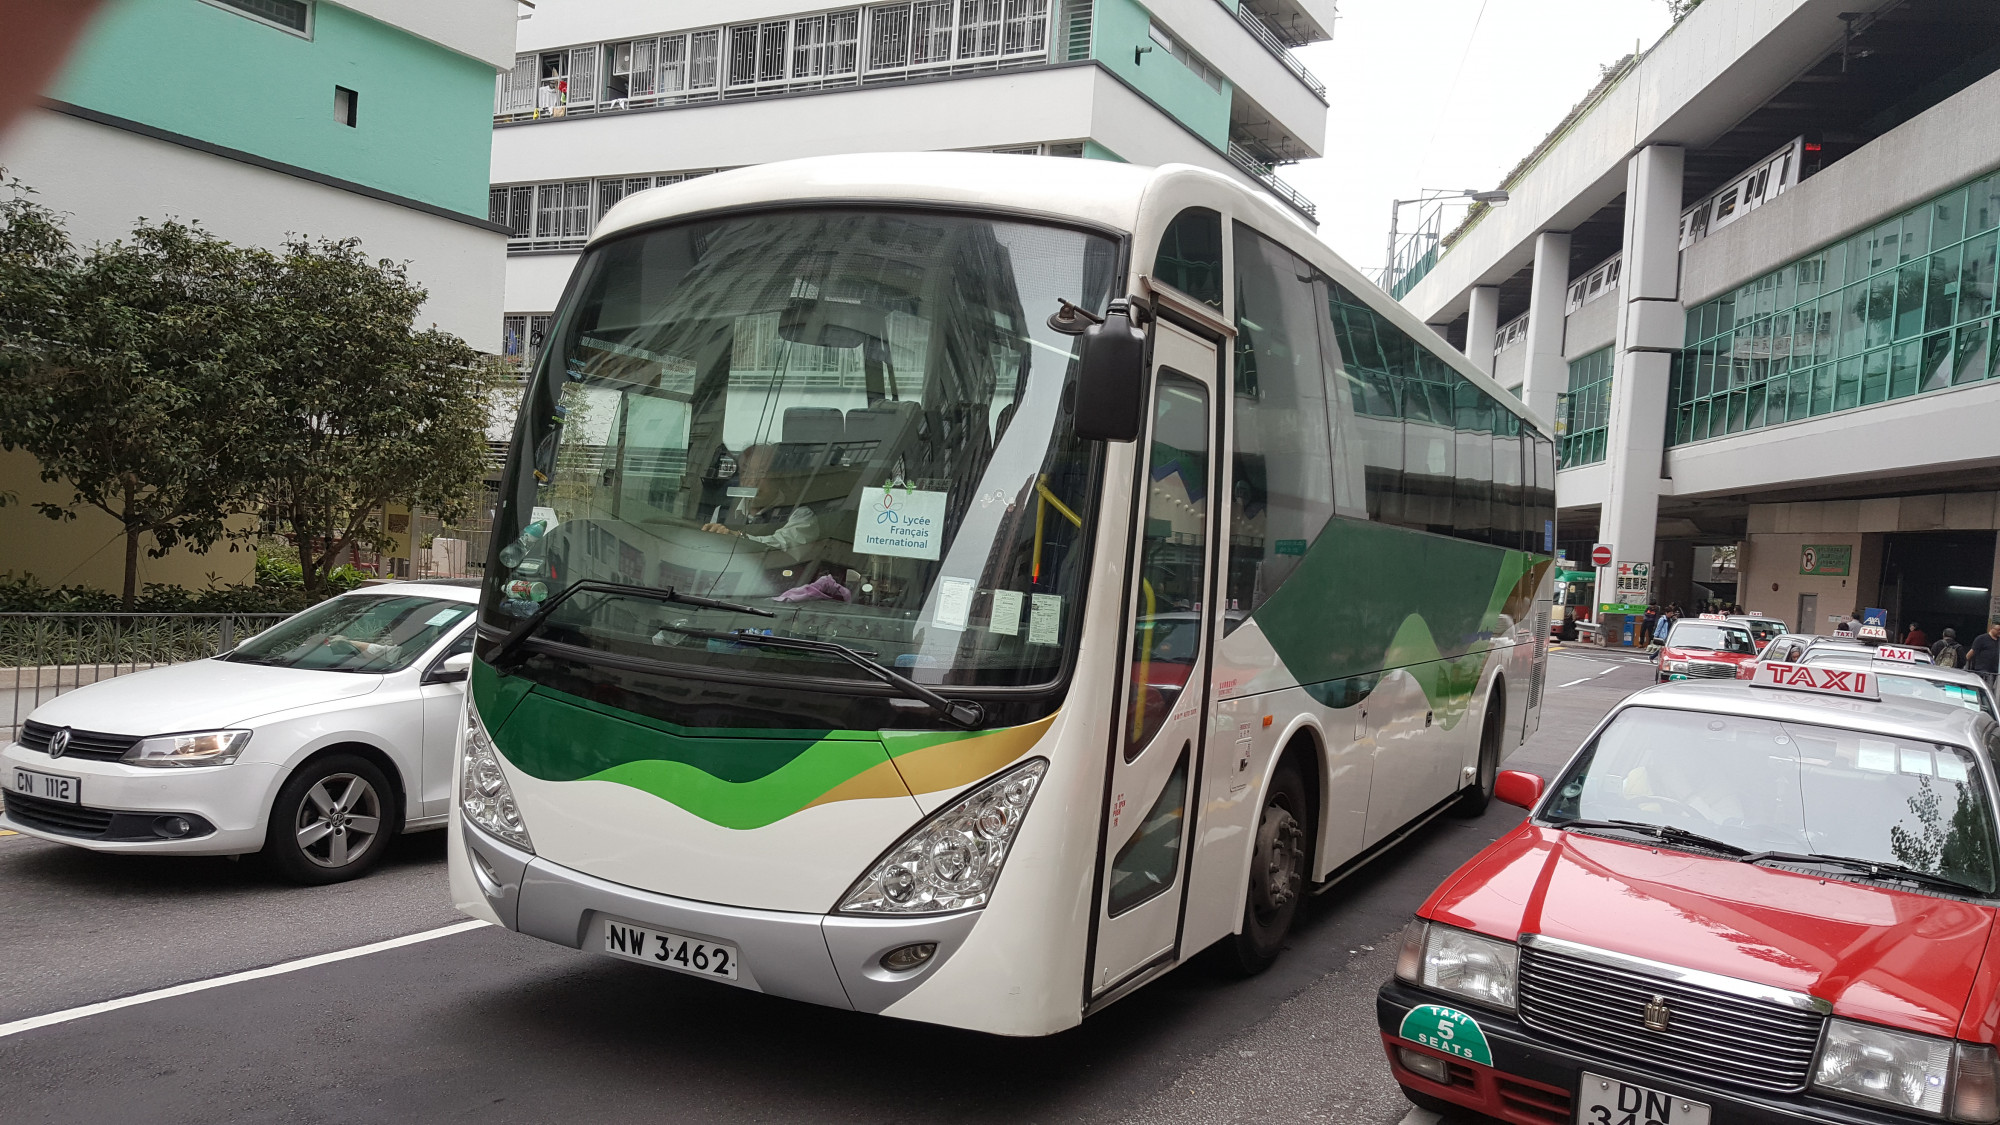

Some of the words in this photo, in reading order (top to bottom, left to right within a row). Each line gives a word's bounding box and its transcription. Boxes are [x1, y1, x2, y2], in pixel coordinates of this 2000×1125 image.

[903, 515, 931, 526] Lycée
[890, 526, 929, 538] Français
[866, 535, 928, 549] International
[1863, 616, 1881, 625] AXA
[1862, 628, 1884, 636] TAXI
[1880, 648, 1912, 660] TAXI
[1766, 663, 1867, 693] TAXI
[17, 772, 33, 793] CN
[45, 777, 69, 799] 1112
[610, 924, 645, 956] NW
[654, 935, 729, 975] 3462
[1430, 1006, 1468, 1025] TAXI
[1437, 1019, 1454, 1040] 5
[1418, 1033, 1473, 1058] SEATS
[1617, 1083, 1672, 1124] DN
